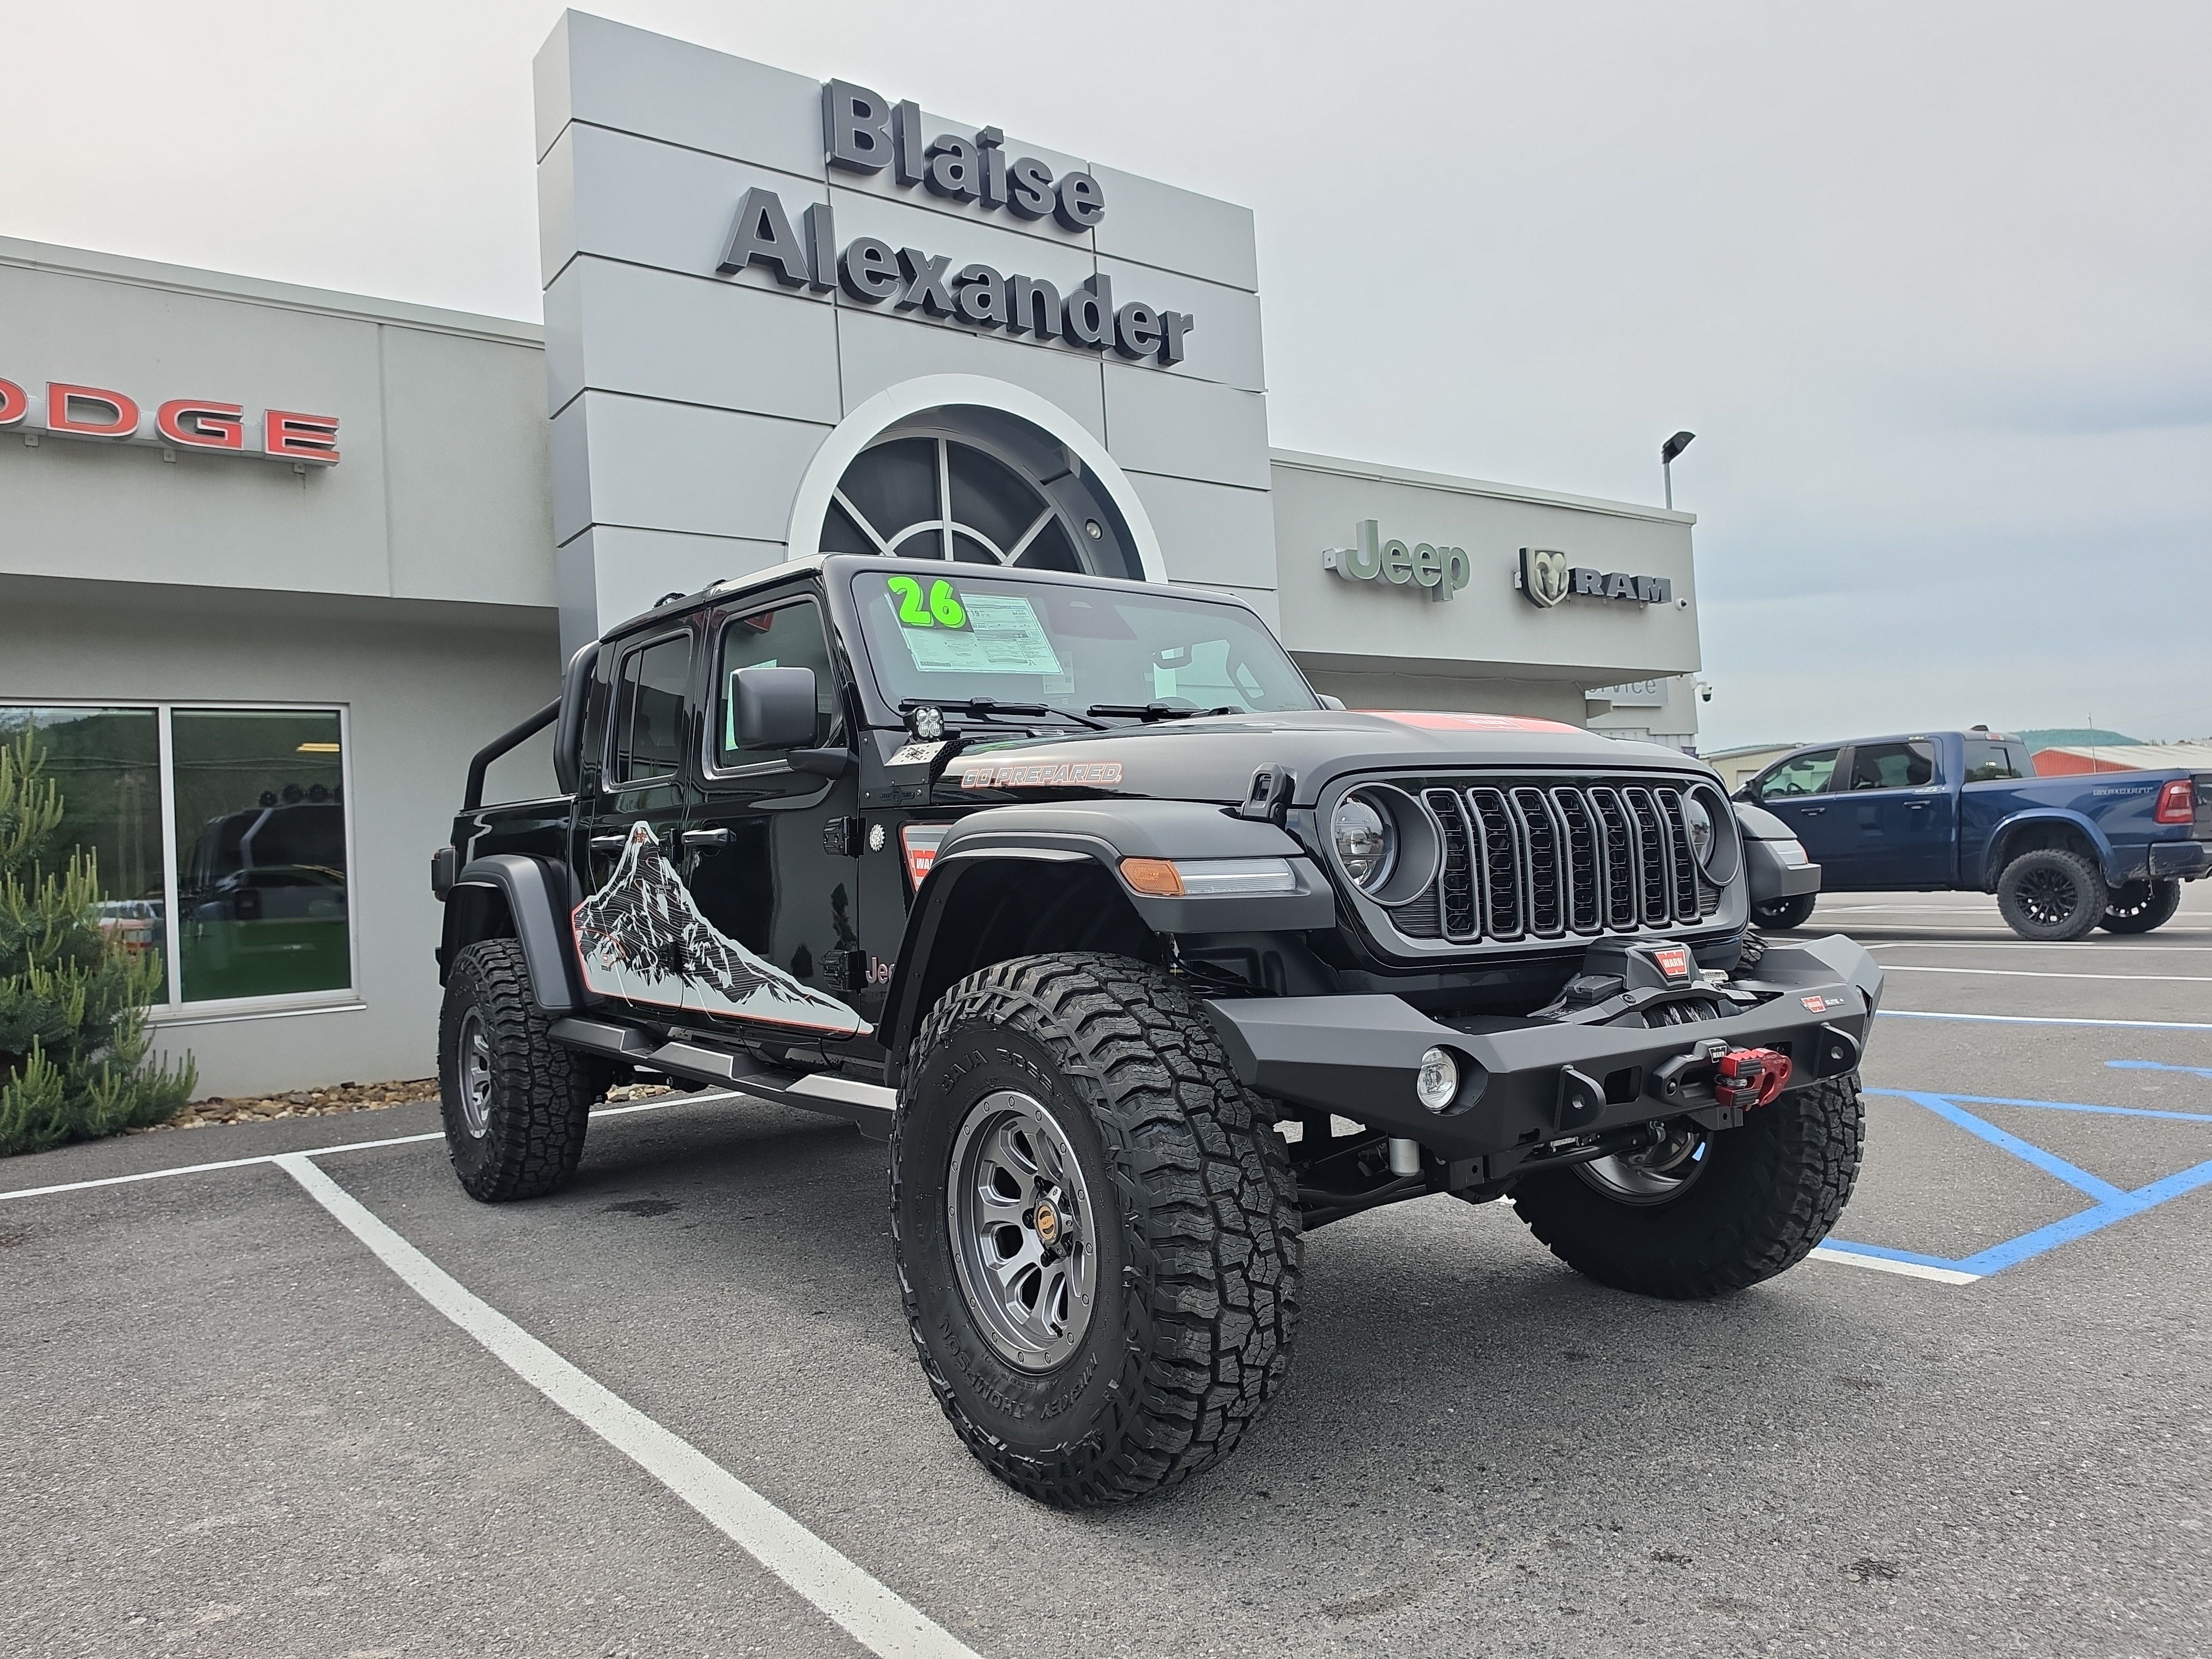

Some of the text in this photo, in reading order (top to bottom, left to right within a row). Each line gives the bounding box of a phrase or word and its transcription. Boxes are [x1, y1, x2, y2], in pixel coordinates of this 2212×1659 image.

[822, 78, 1104, 233] Blaise
[716, 187, 1193, 367] Alexander
[1336, 519, 1470, 602] Jeep
[888, 576, 966, 628] 26
[1569, 568, 1672, 604] RAM
[962, 768, 993, 788] GO
[916, 858, 934, 870] WA
[1662, 957, 1684, 968] WARN
[940, 1049, 988, 1096] BAJA
[1712, 1051, 1725, 1059] WARN
[937, 1315, 1026, 1420] THOMPSON
